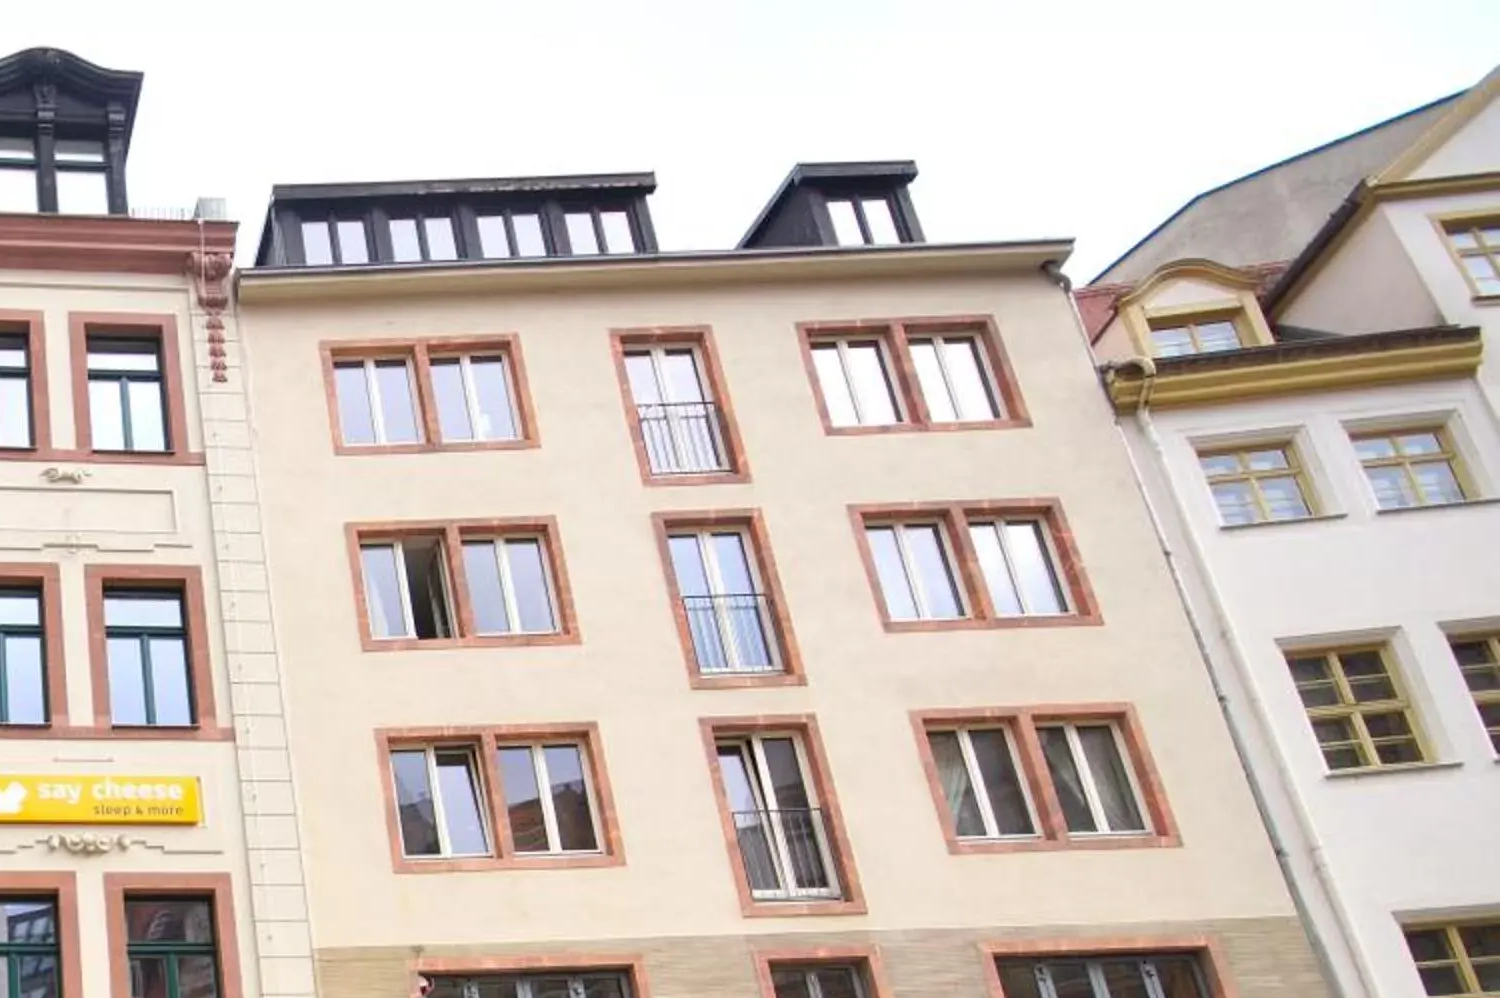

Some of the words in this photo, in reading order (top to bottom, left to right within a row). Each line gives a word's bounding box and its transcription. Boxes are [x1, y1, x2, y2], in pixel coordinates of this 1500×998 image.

[37, 781, 82, 804] say
[92, 776, 184, 800] cheese
[93, 803, 132, 816] sleep
[147, 804, 185, 816] more
